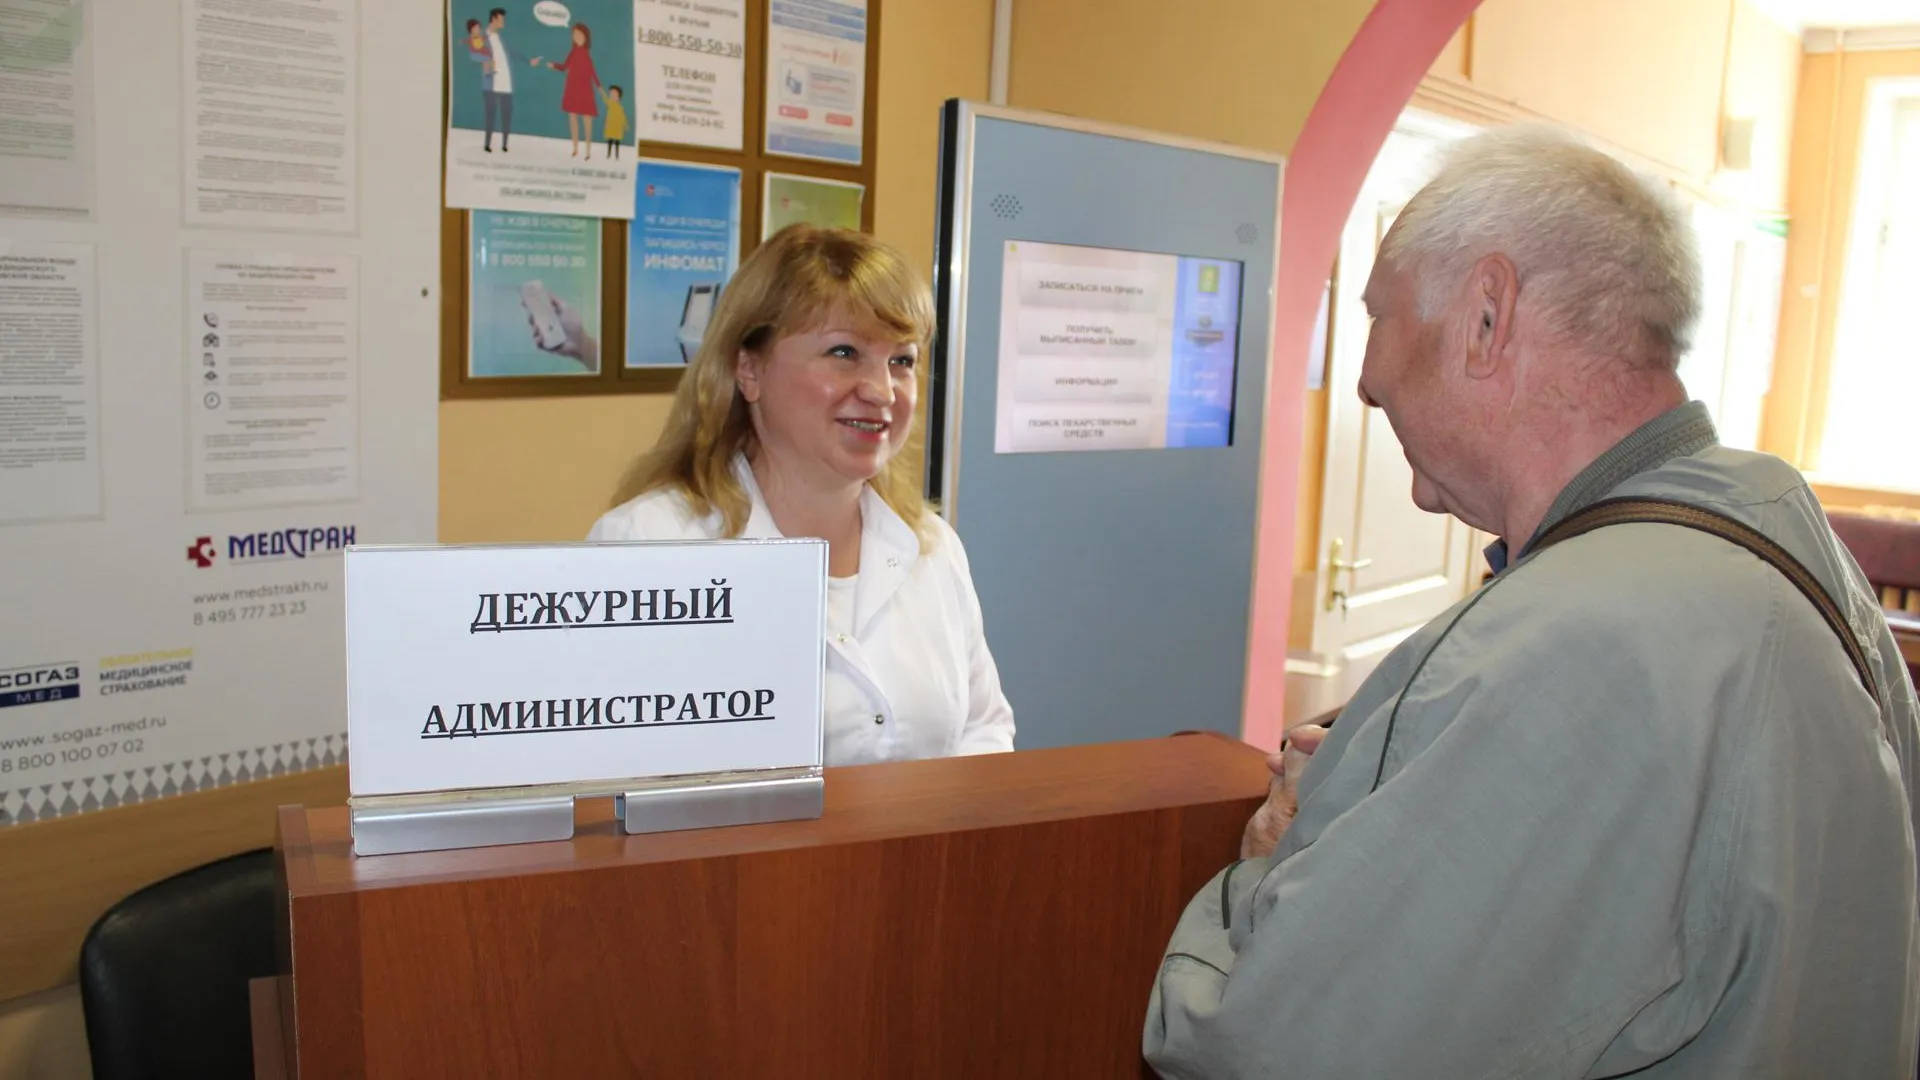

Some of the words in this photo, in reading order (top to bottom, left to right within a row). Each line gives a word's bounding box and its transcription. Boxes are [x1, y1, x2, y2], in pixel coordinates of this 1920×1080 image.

[661, 64, 716, 83] ТЕЛЕФОН
[644, 253, 725, 272] ИНФОМАТ
[228, 525, 356, 558] МЕДСТРАХ
[192, 580, 329, 605] www.medstrakh.ru
[193, 611, 204, 626] 8
[208, 608, 237, 623] 495
[241, 605, 266, 620] 777
[269, 603, 286, 618] 23
[289, 600, 307, 615] 23
[470, 578, 734, 634] ДЕЖУРНЫЙ
[0, 666, 79, 688] СОГАЗ
[99, 660, 193, 682] МЕДИЦИНСКОЕ
[16, 688, 64, 704] МЕД
[100, 674, 188, 697] СТРАХОВАНИЕ
[421, 689, 775, 740] АДМИНИСТРАТОР
[0, 716, 167, 750] www.sogaz-med.ru
[1, 758, 13, 774] 8
[18, 751, 56, 771] 800
[61, 746, 92, 764] 100
[96, 742, 119, 760] 07
[122, 738, 144, 754] 02
